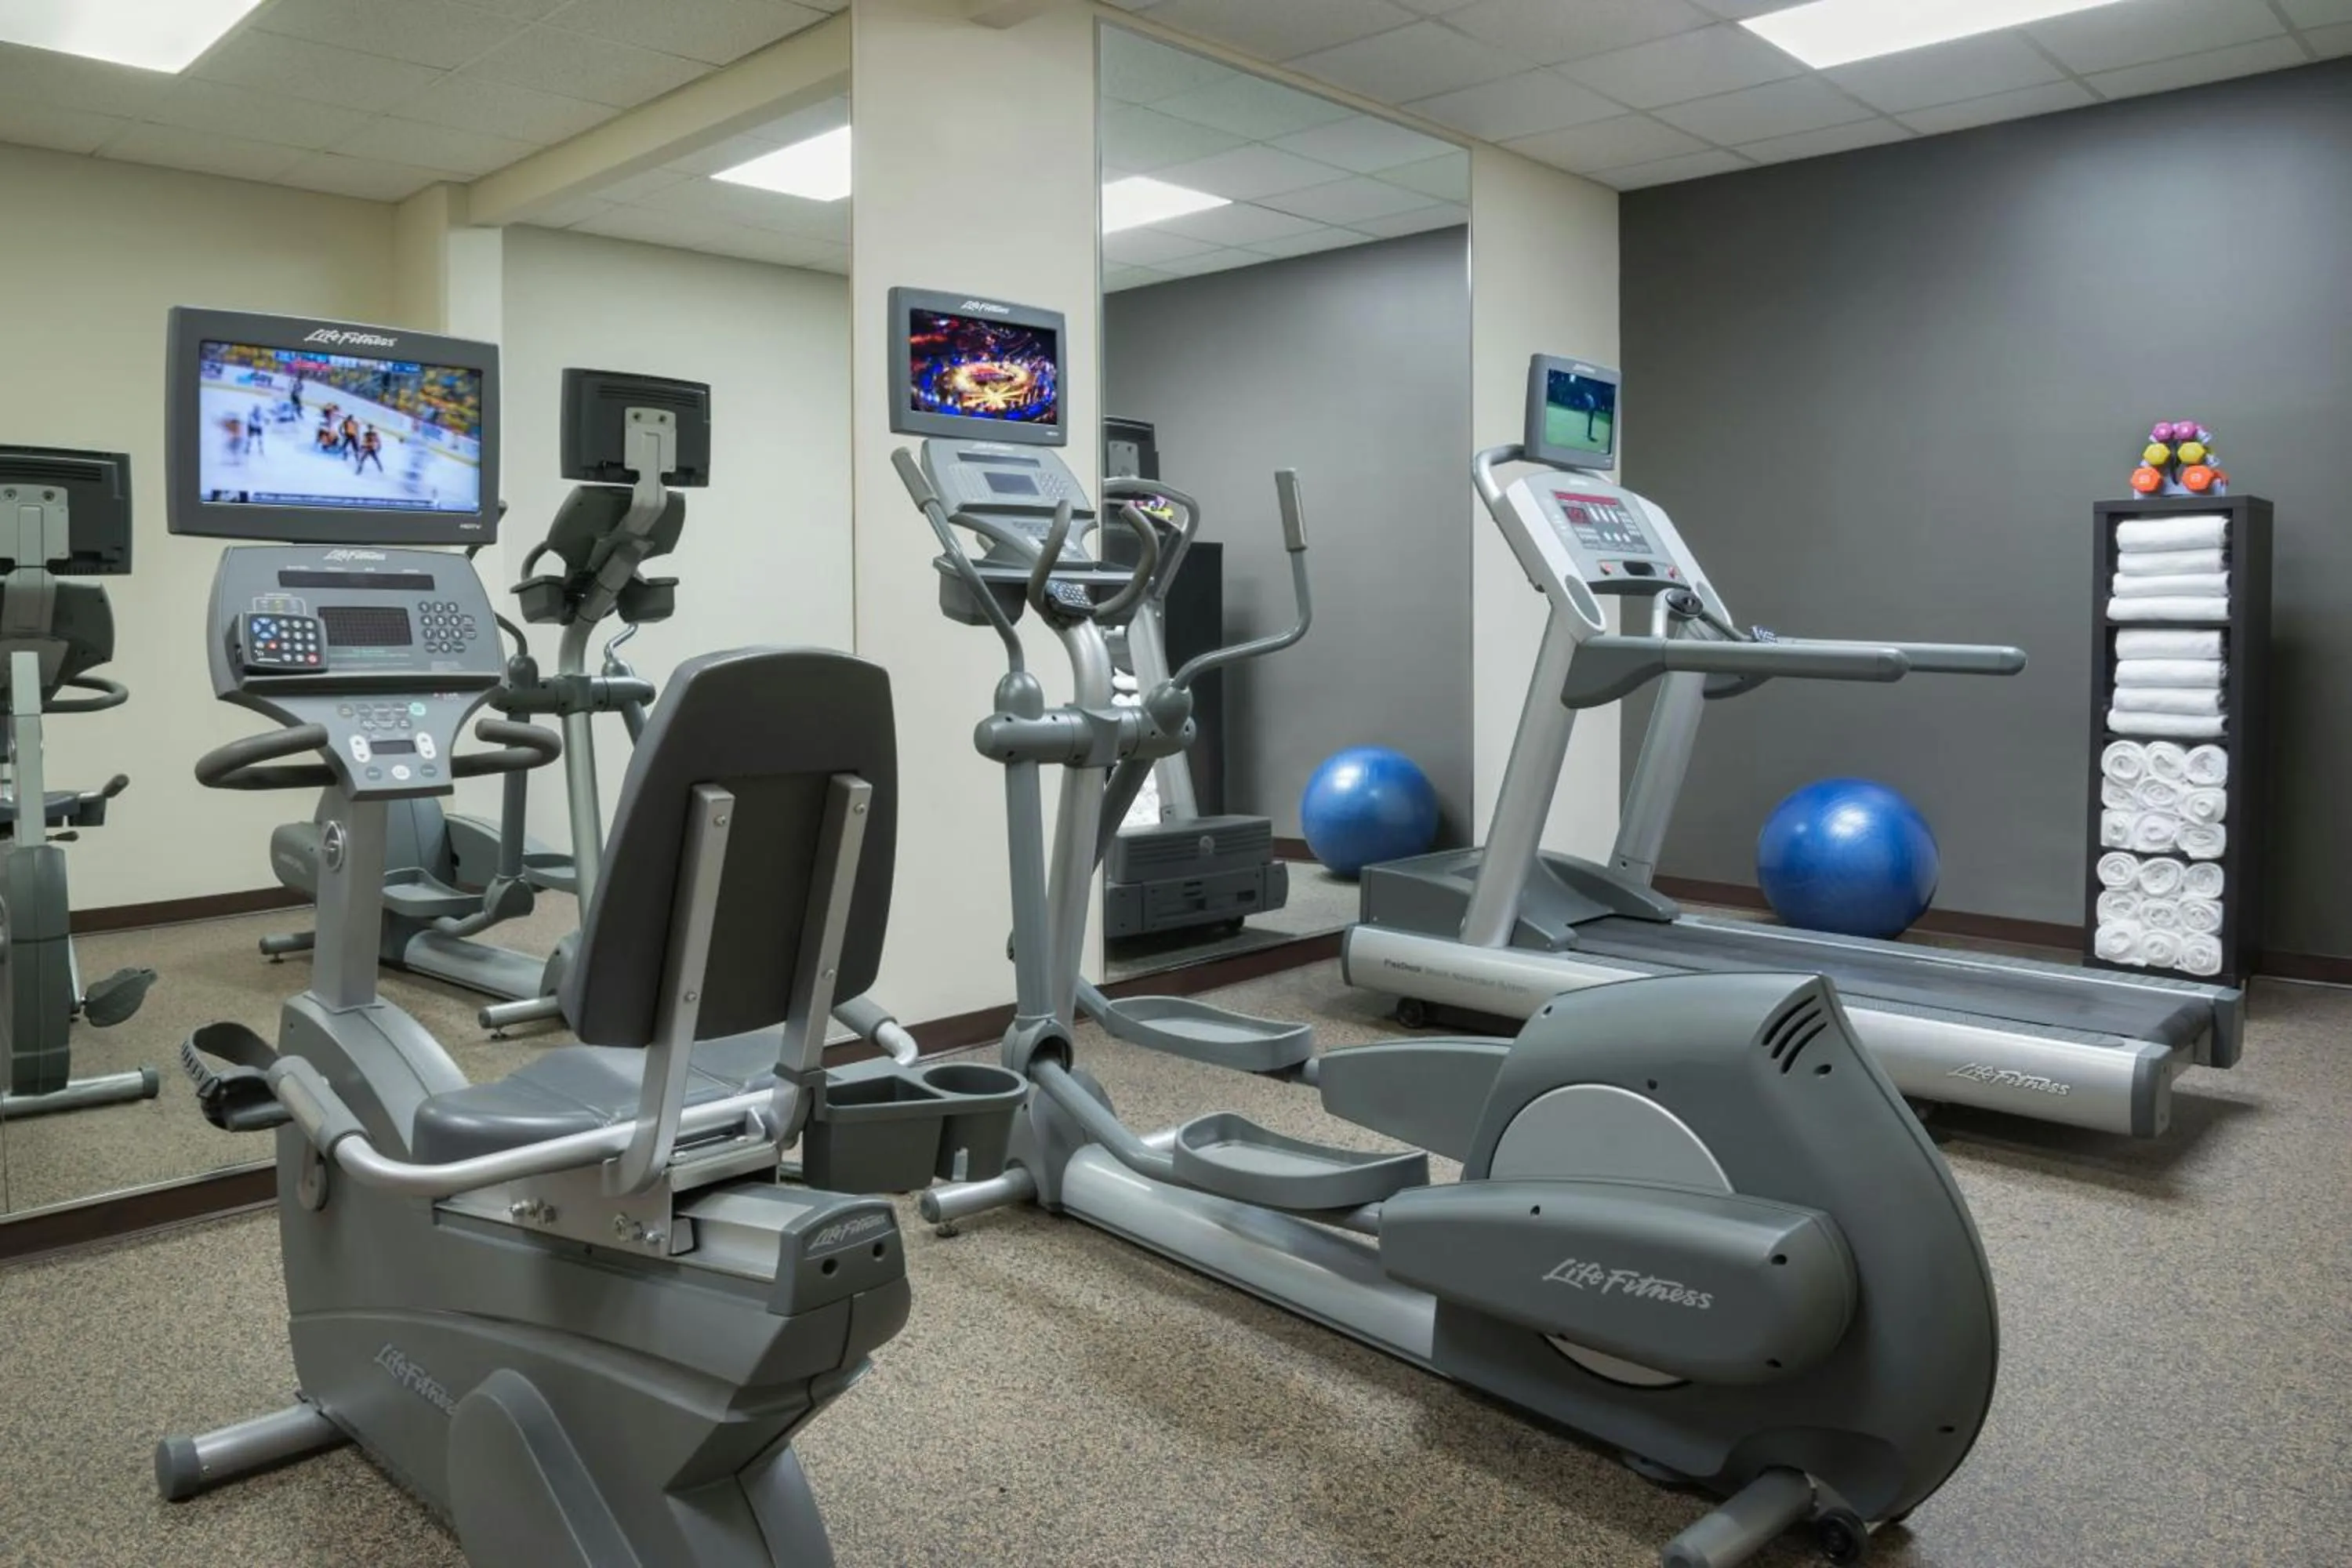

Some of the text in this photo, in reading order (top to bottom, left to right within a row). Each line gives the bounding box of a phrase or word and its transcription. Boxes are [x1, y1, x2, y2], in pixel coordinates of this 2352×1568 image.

[303, 328, 341, 344] Life
[1946, 1062, 2071, 1095] Life Fitness
[1541, 1258, 1715, 1310] Life Fitness
